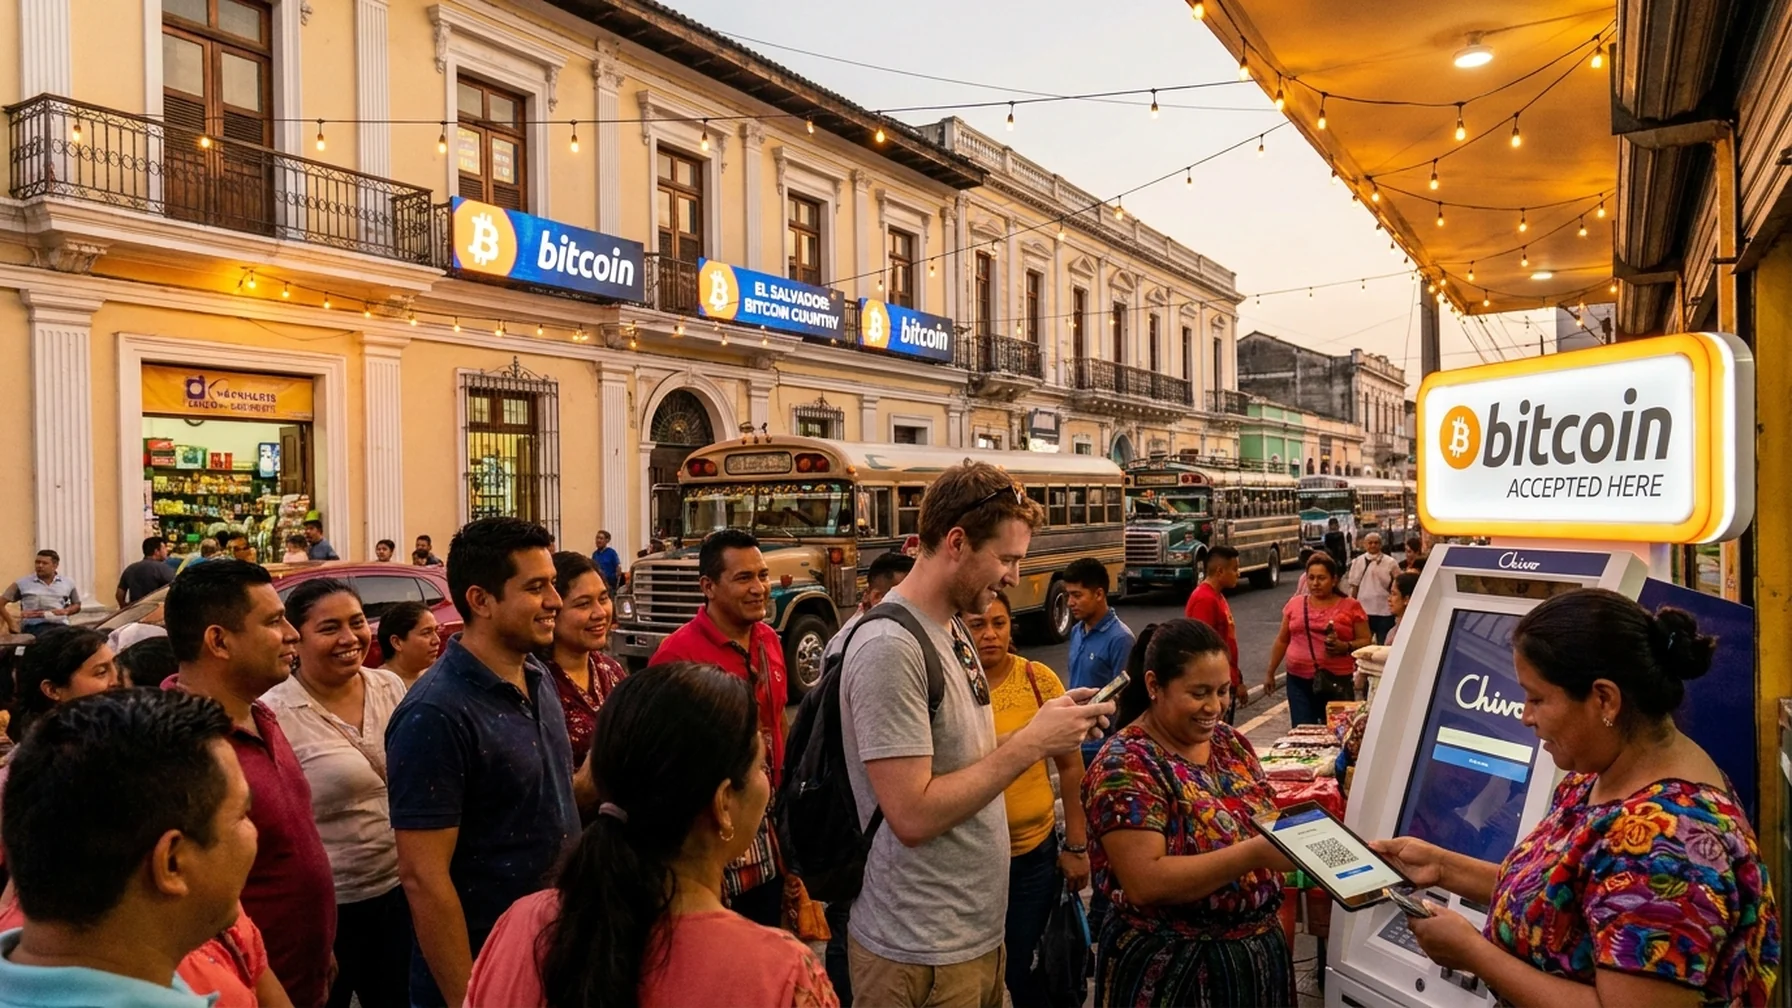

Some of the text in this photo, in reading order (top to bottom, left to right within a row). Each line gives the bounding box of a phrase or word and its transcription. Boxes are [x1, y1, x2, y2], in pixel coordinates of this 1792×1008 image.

[537, 229, 635, 287] bitcoin
[754, 281, 769, 298] EL
[900, 316, 949, 351] bitcoin
[1482, 387, 1673, 468] bitcoin
[1506, 474, 1664, 498] ACCEPTED HERE
[1455, 673, 1526, 719] Chivo
